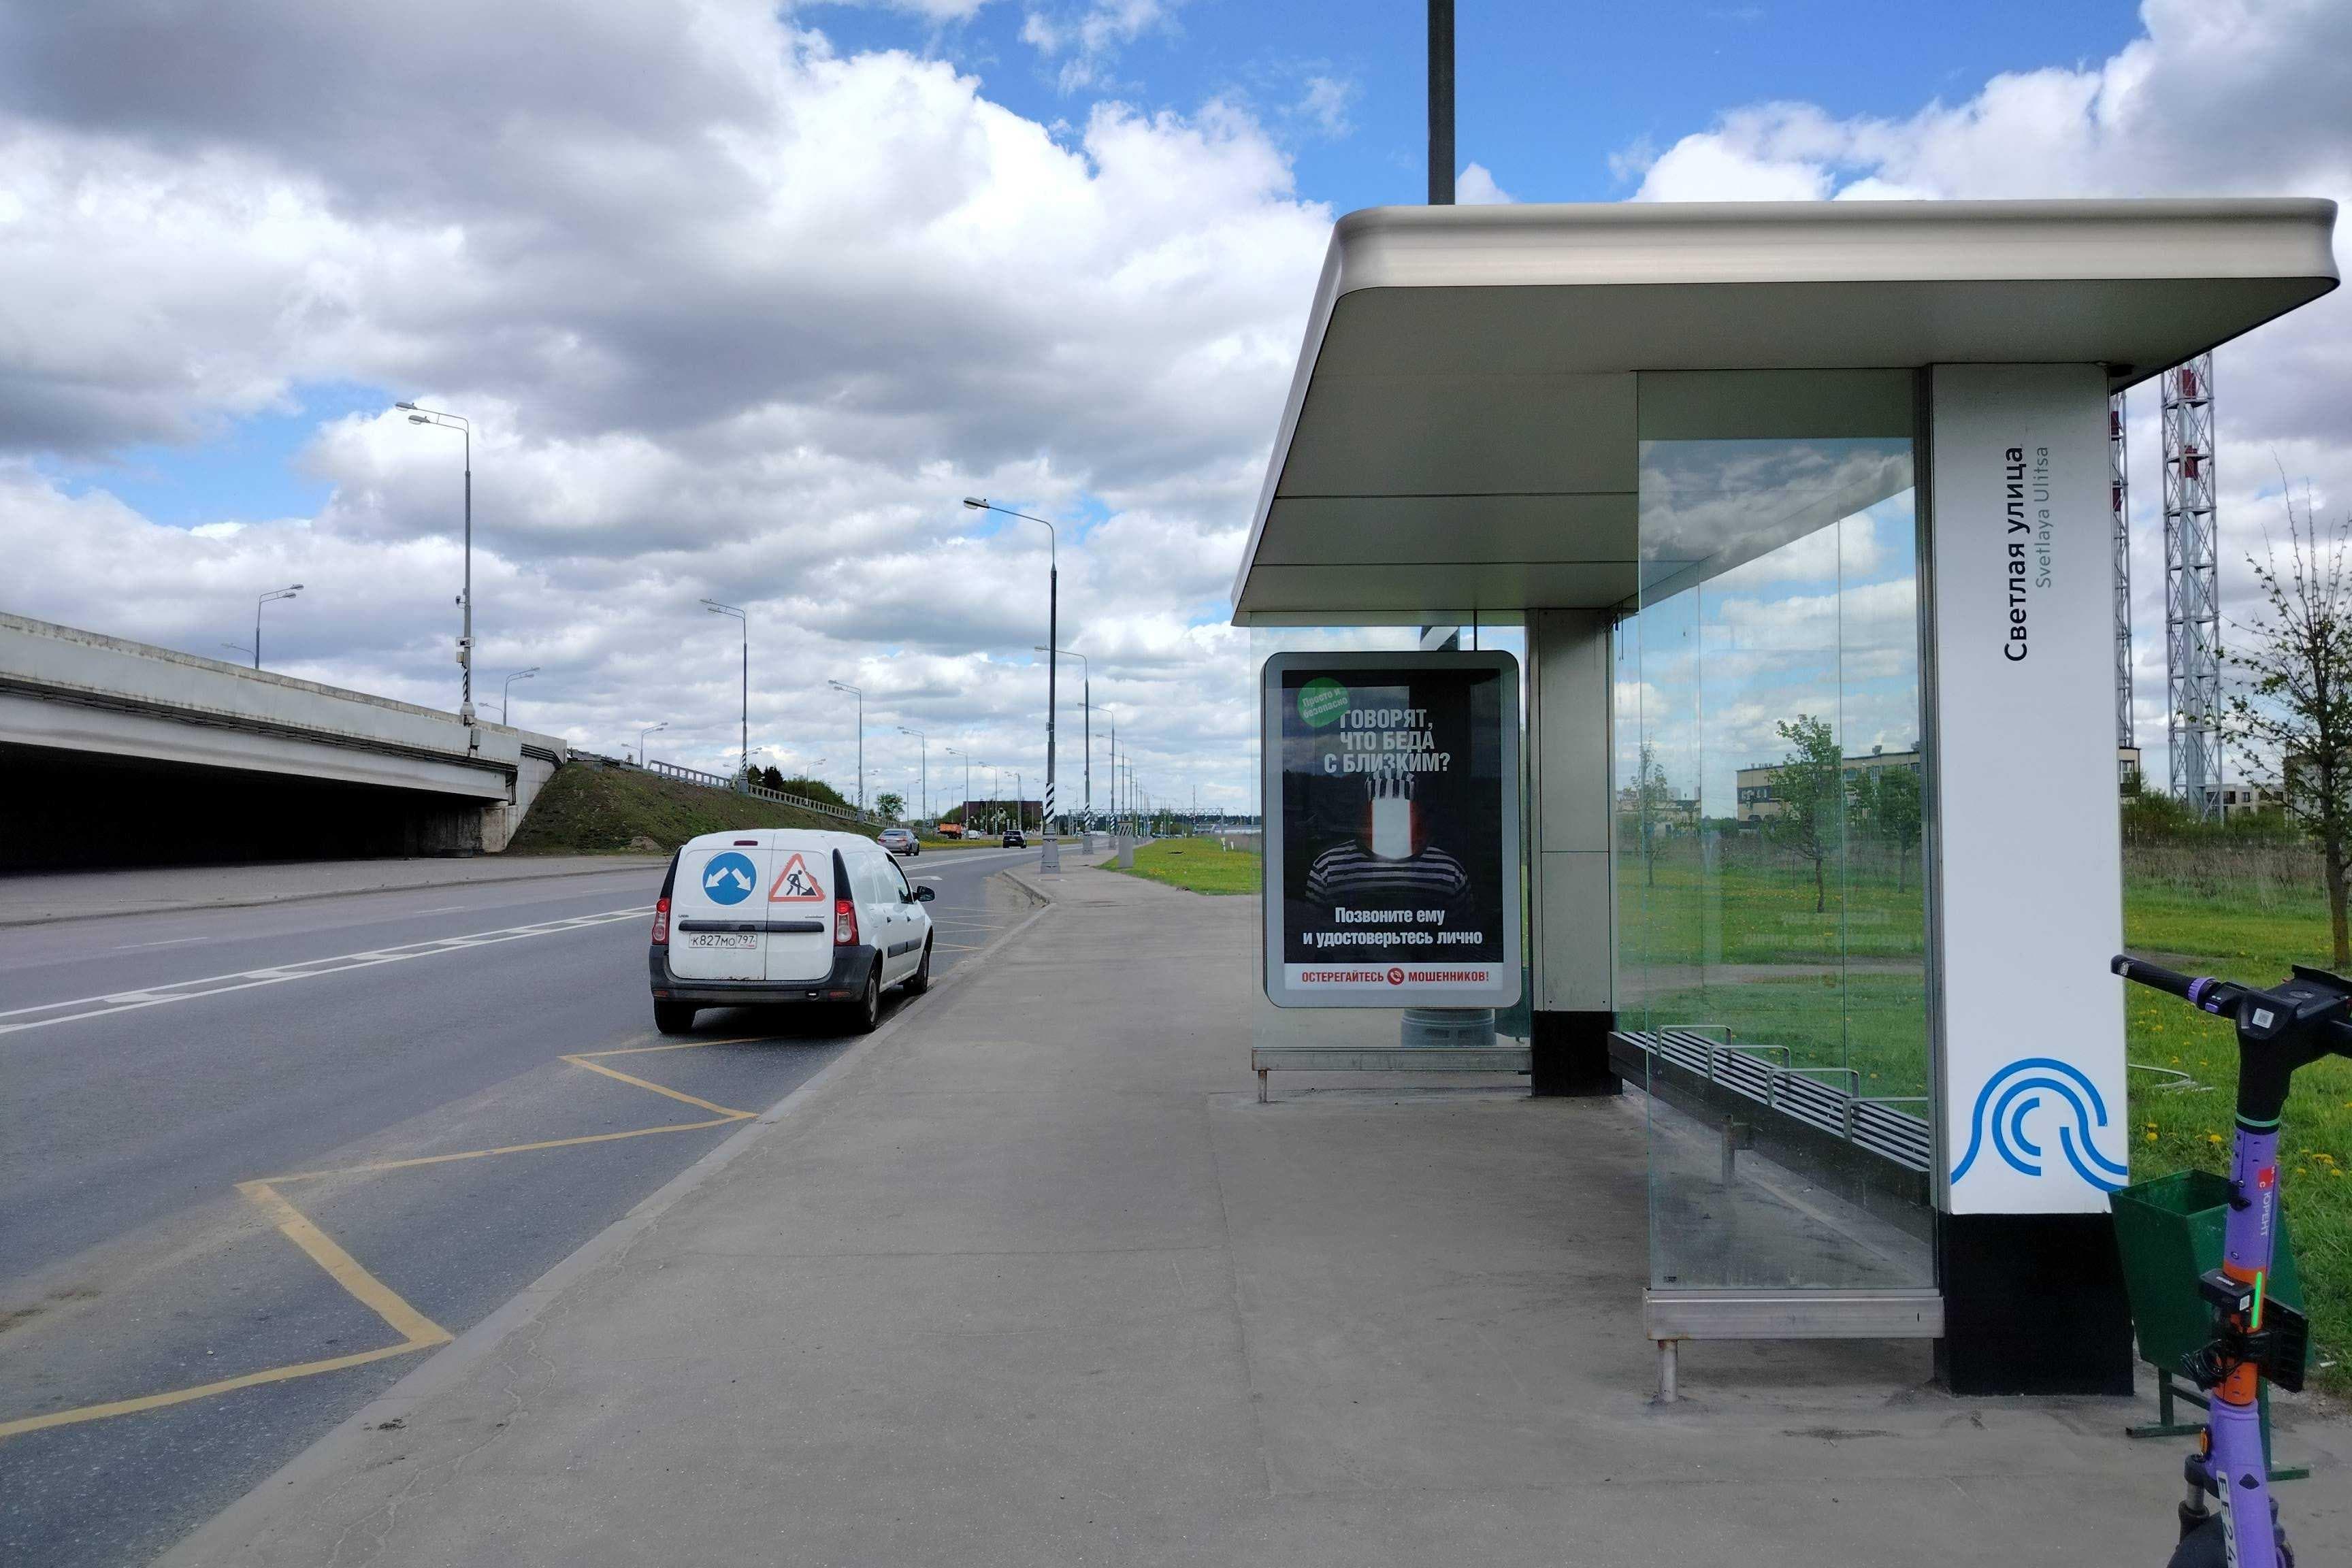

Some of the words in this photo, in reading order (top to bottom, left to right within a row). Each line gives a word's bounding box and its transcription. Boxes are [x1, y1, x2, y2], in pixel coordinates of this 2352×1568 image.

[2032, 446, 2049, 502] Ulitsa
[2005, 446, 2030, 534] улица
[2034, 508, 2054, 588] Svetlaya
[2004, 543, 2027, 662] Светлая
[1301, 689, 1333, 708] Просто
[1303, 696, 1349, 719] безопасно
[1339, 708, 1433, 731] ГОВОРЯТ,
[1340, 731, 1377, 751] ЧТО
[1382, 730, 1435, 753] БЕДА
[1324, 753, 1337, 773] С
[1343, 752, 1451, 773] БЛИЗКИМ?
[1335, 906, 1414, 923] Позвоните
[1416, 909, 1446, 926] ему
[1303, 932, 1313, 945] и
[1316, 931, 1433, 948] удостоверьтесь
[1437, 931, 1484, 945] лично
[1302, 970, 1384, 982] ОСТЕРЕГАЙТЕСЬ
[1408, 971, 1489, 982] МОШЕННИКОВ!
[2259, 1192, 2272, 1237] ЮРЕНТ
